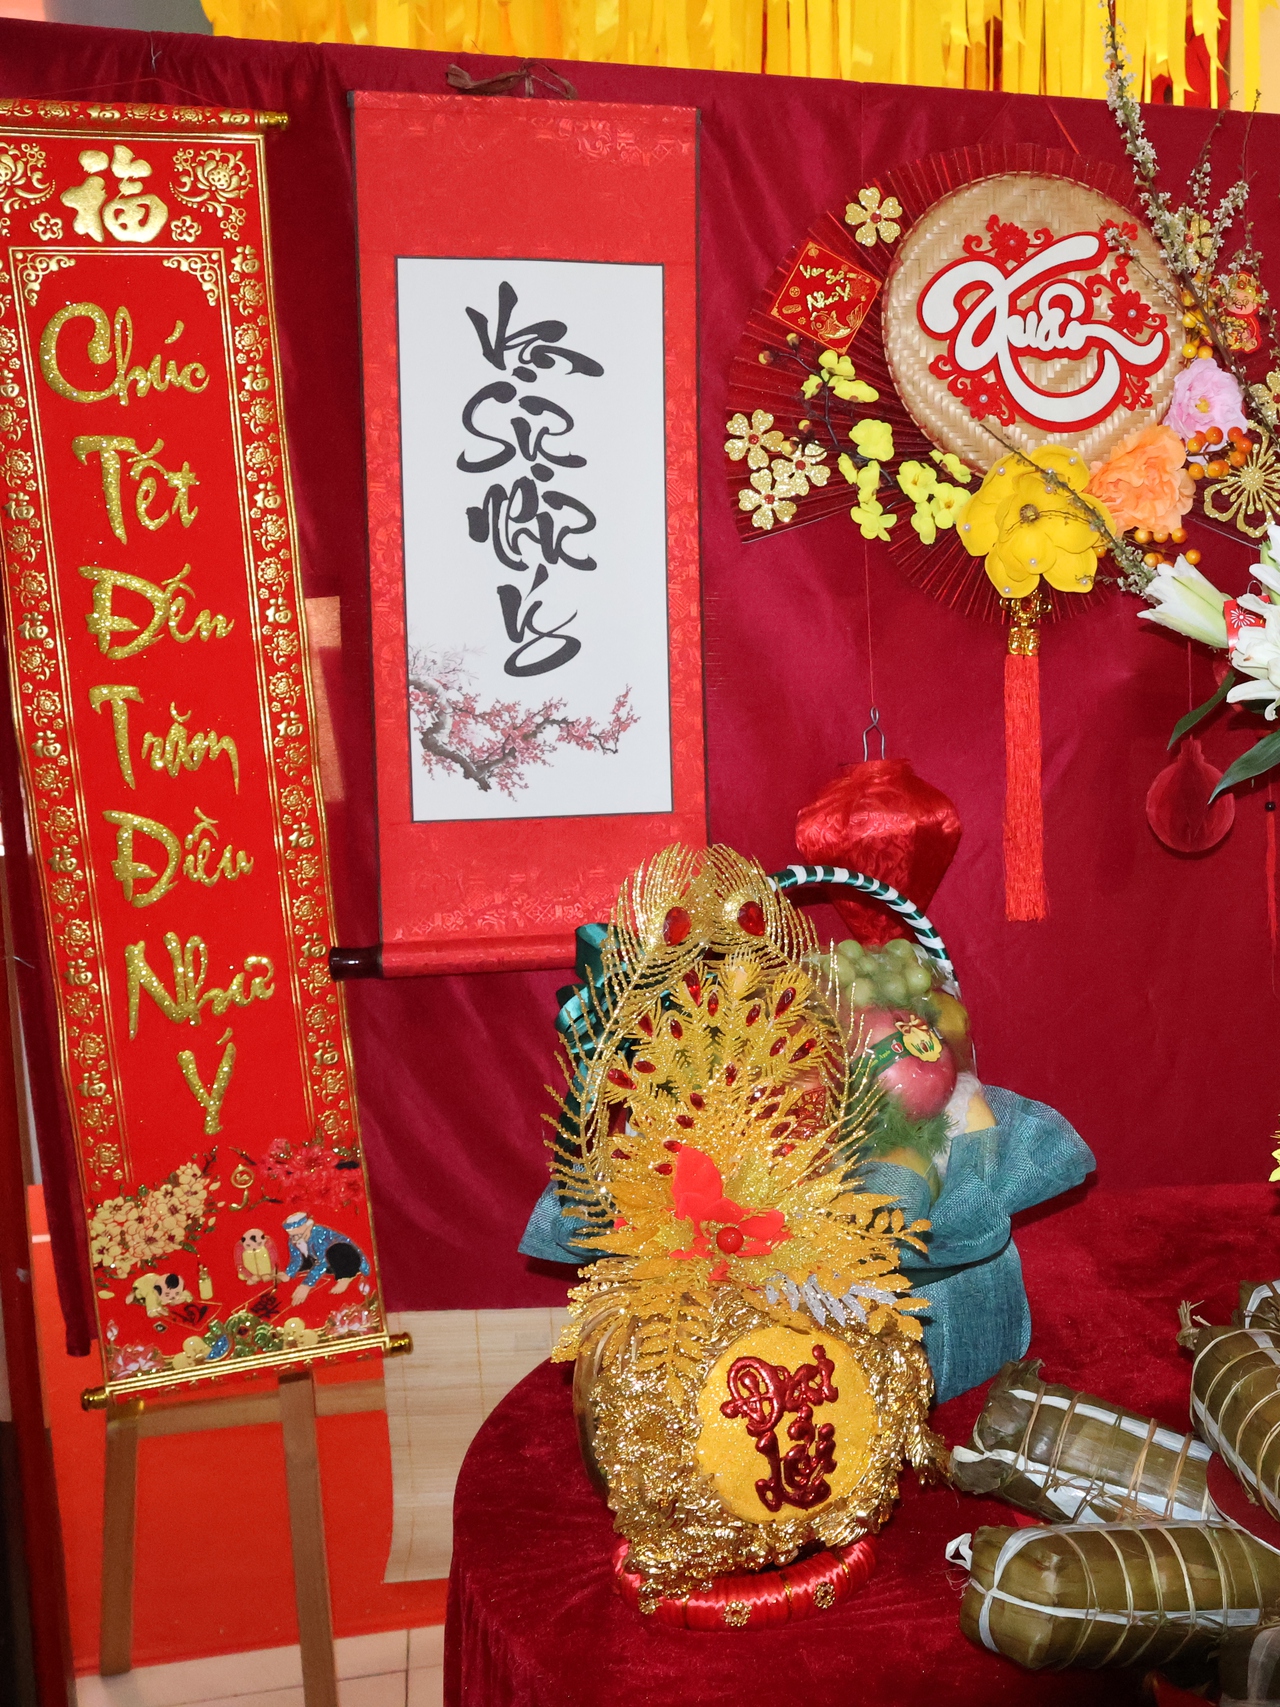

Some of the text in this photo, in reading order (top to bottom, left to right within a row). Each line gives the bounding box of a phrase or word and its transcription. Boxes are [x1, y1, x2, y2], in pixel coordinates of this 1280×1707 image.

[60, 144, 169, 243] 福
[39, 300, 210, 406] Chúc
[919, 233, 1164, 423] Xuân
[71, 434, 201, 545] Tết
[78, 563, 236, 660] Đến
[88, 683, 240, 796] Trăm
[102, 805, 255, 908] Điều
[124, 931, 276, 1040] Như
[176, 1028, 237, 1136] Ý
